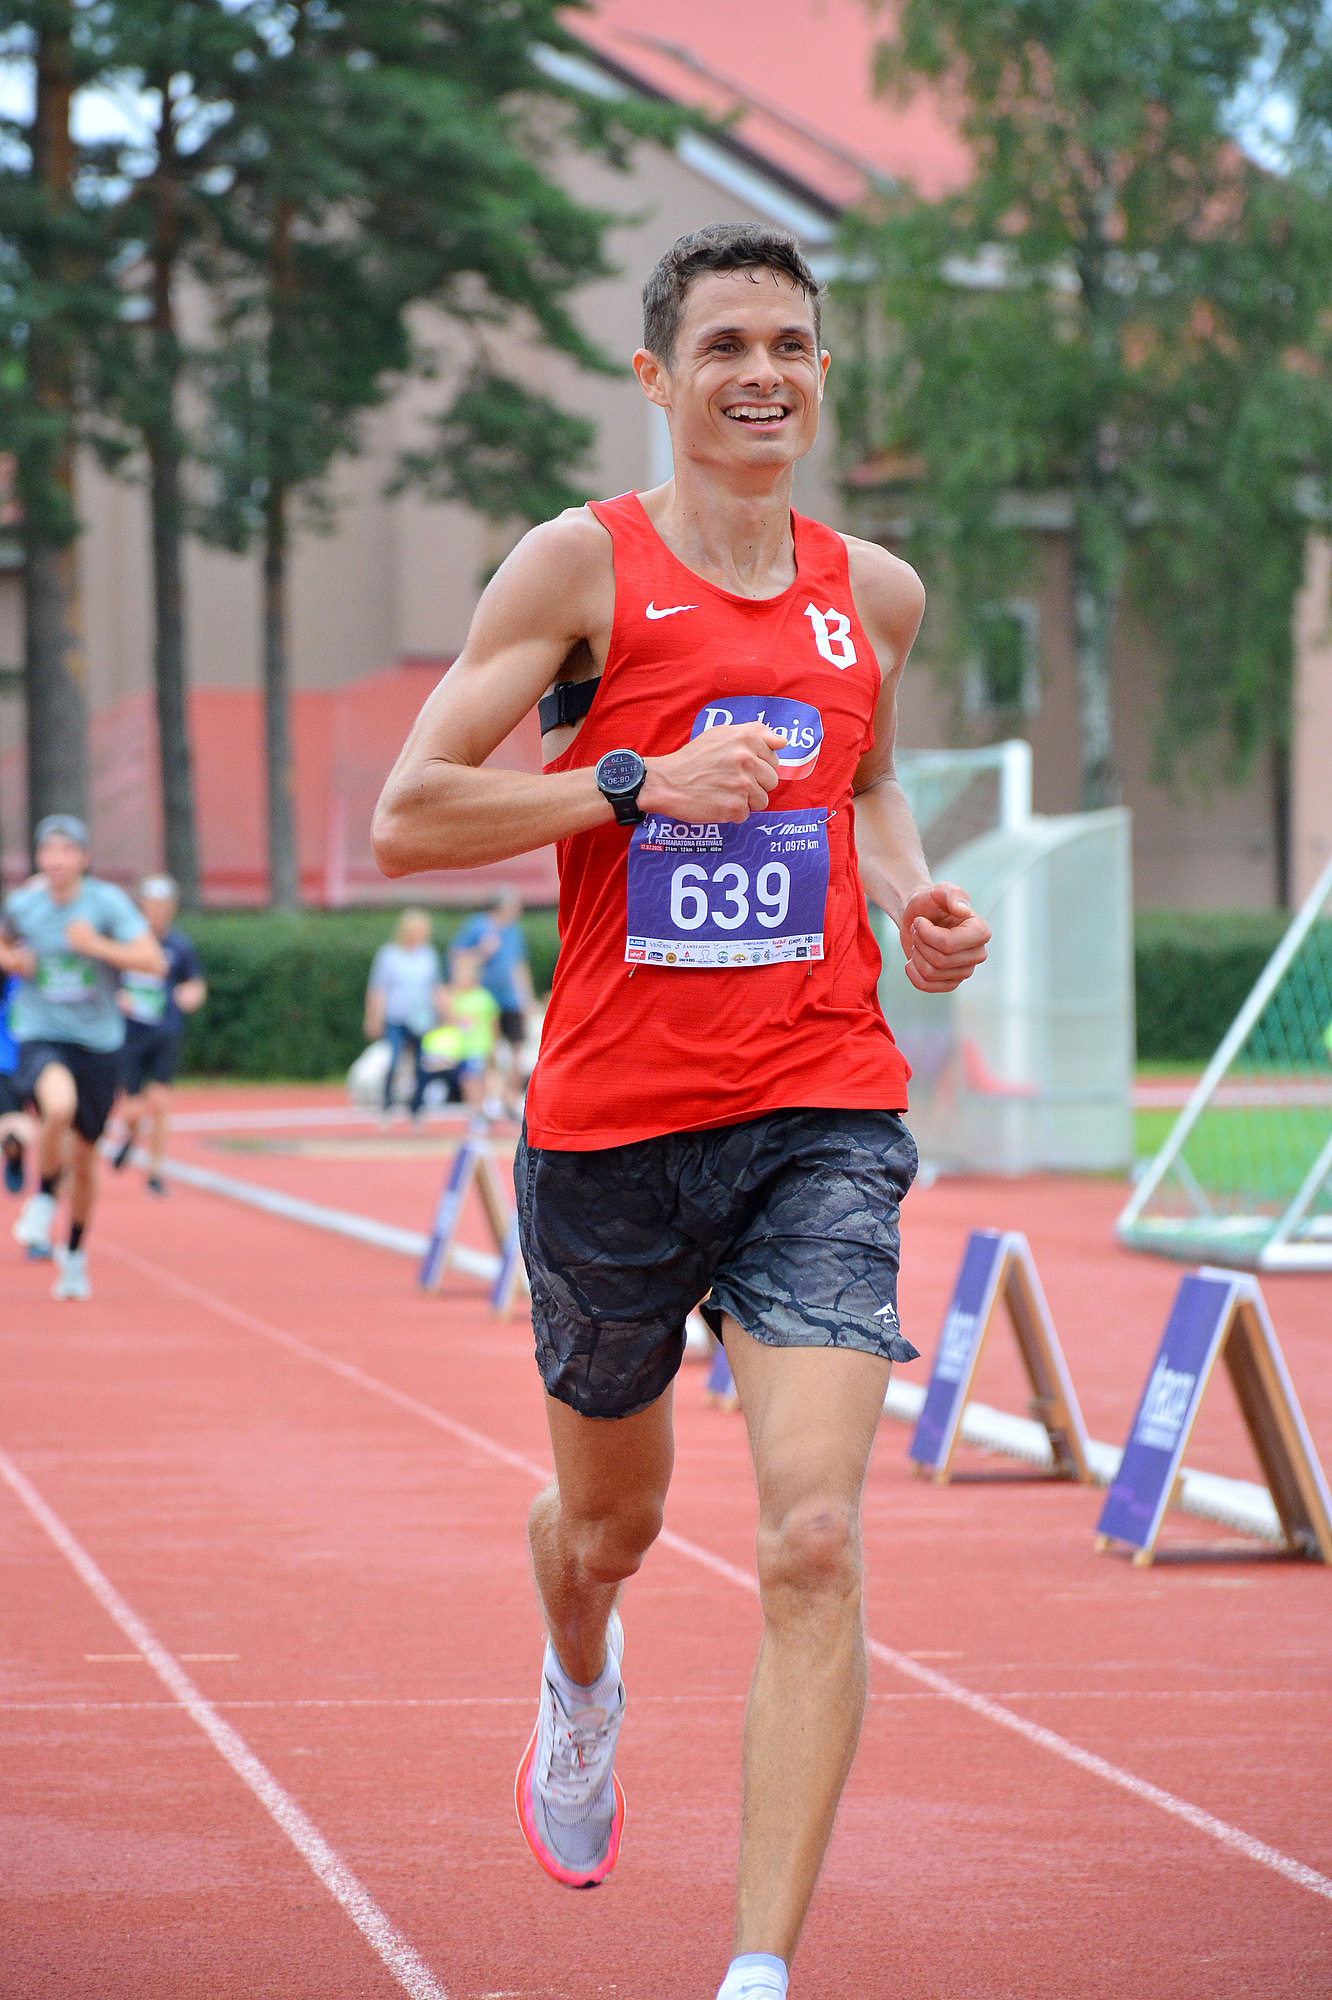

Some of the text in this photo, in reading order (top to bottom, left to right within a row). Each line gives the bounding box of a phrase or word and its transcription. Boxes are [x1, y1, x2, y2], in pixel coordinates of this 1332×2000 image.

[659, 823, 721, 838] ROJA
[770, 839, 819, 853] 21,0975 km
[670, 861, 791, 930] 639
